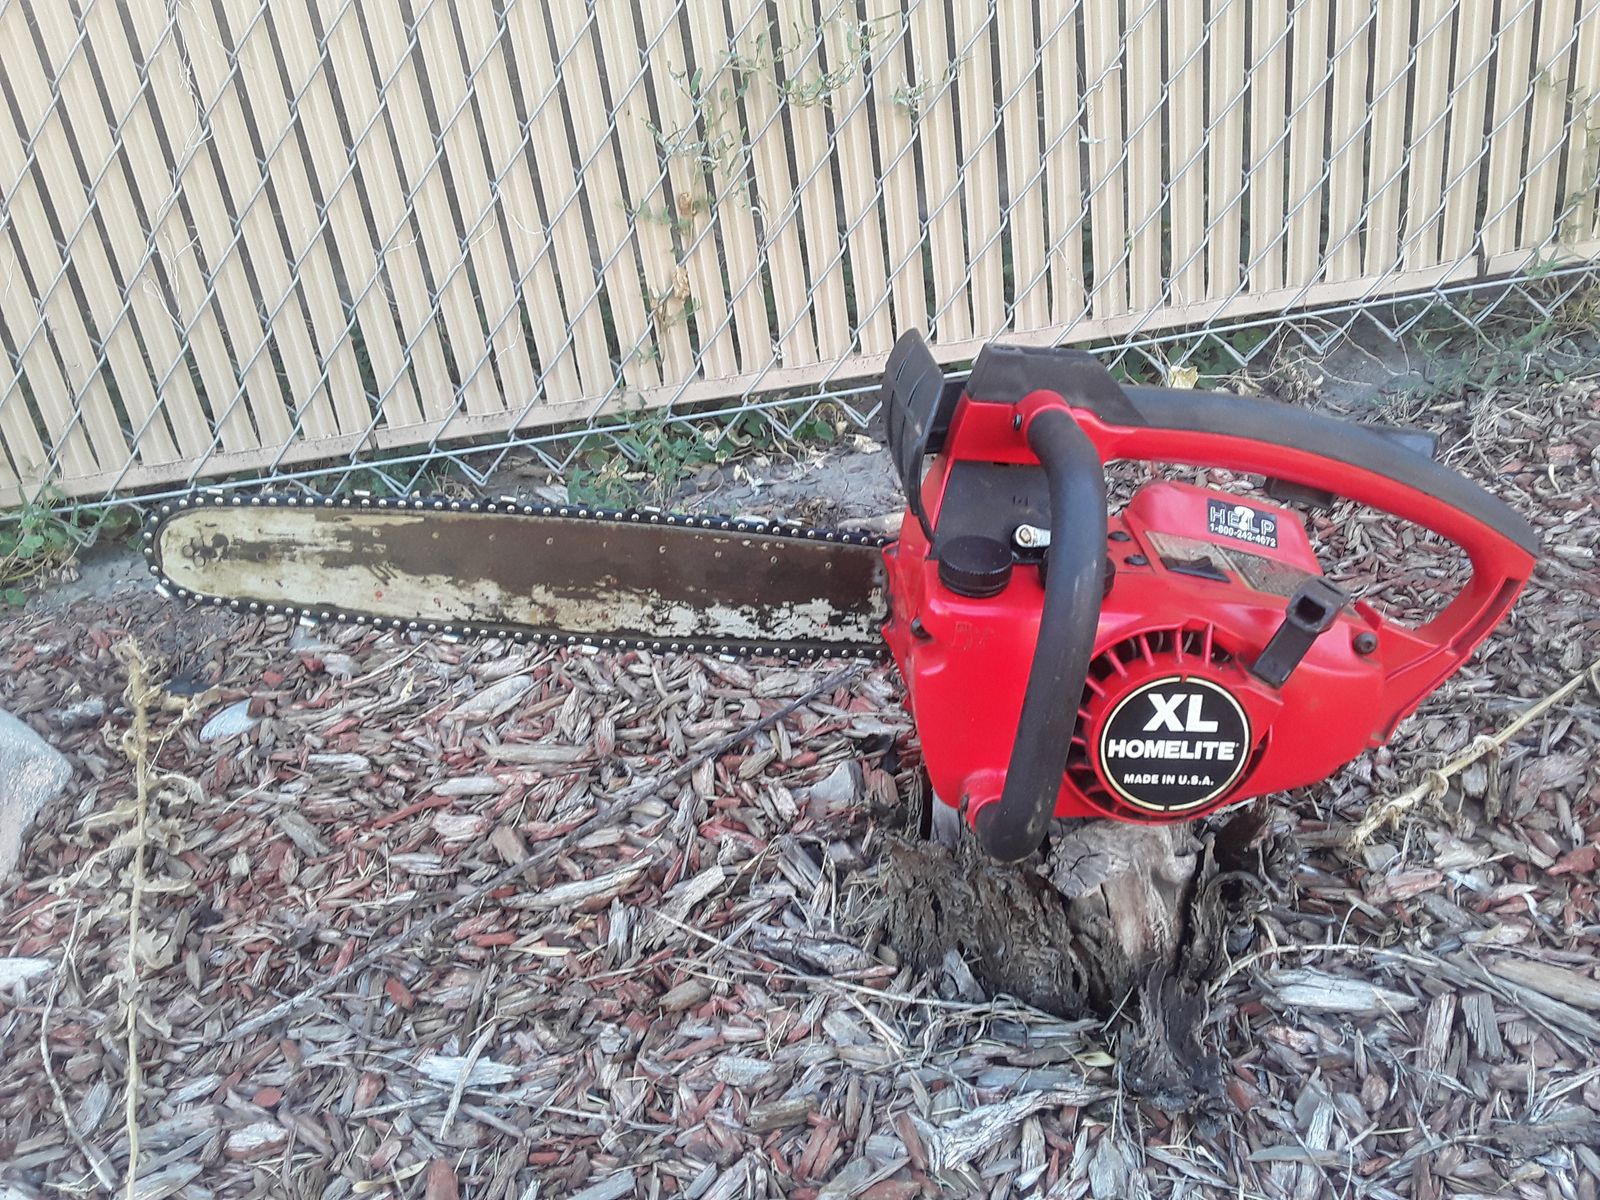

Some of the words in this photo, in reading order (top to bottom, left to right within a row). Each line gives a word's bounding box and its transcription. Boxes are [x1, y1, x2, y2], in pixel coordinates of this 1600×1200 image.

[1210, 523, 1276, 547] 1-800-242-4672
[1142, 693, 1219, 733] XL
[1107, 738, 1236, 761] HOMELITE
[1123, 773, 1160, 785] MADE
[1162, 774, 1175, 785] IN
[1178, 775, 1215, 786] U.S.A.
